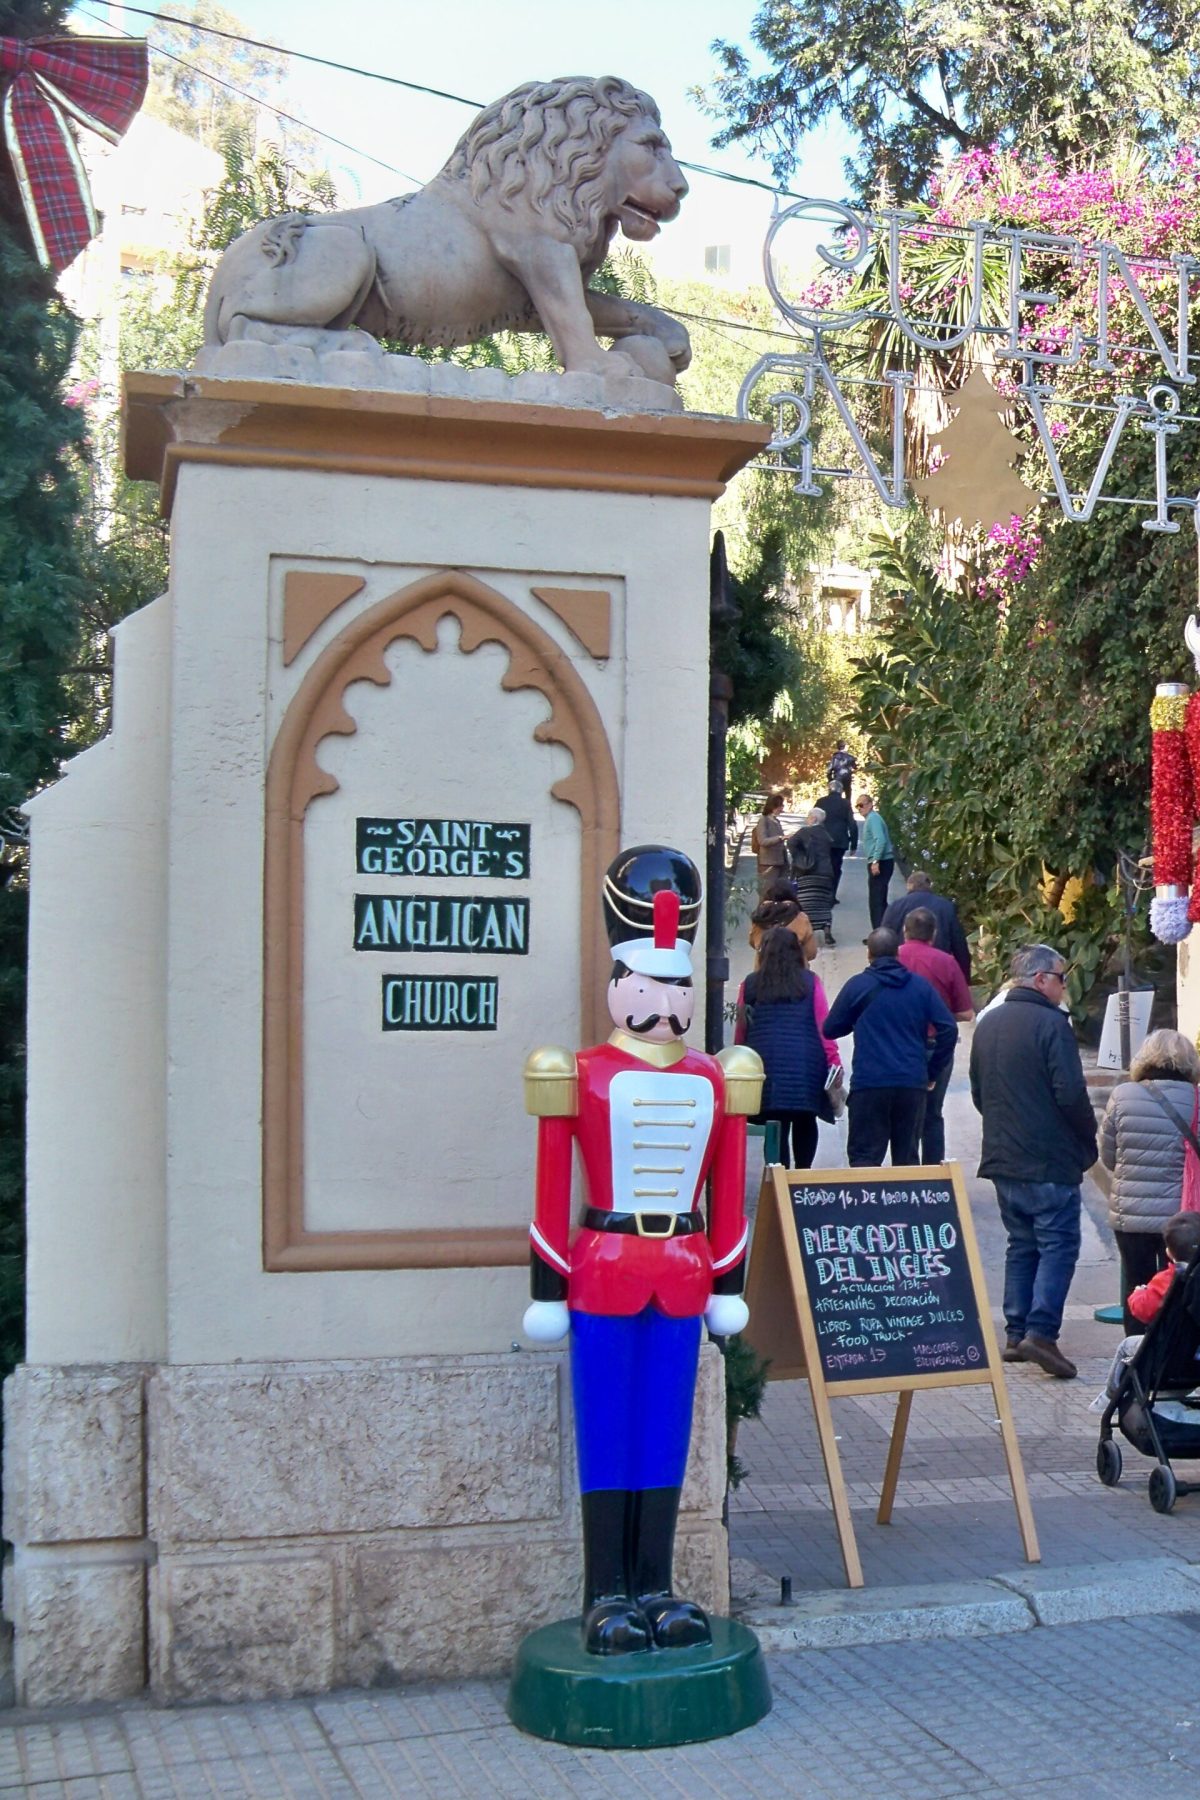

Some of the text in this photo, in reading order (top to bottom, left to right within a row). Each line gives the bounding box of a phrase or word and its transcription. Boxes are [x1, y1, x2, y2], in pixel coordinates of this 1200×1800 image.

[396, 820, 493, 849] SAINT
[361, 846, 525, 877] GEORGE'S
[357, 899, 526, 949] ANGLICAN
[385, 980, 497, 1025] CHURCH
[794, 1187, 836, 1206] SÁBADO
[861, 1189, 878, 1204] DE
[910, 1190, 920, 1207] A
[921, 1189, 950, 1205] 16:00
[802, 1222, 957, 1256] MERCADILLO
[815, 1256, 865, 1285] DEL
[859, 1317, 885, 1332] ROPA
[929, 1310, 965, 1325] DULCES
